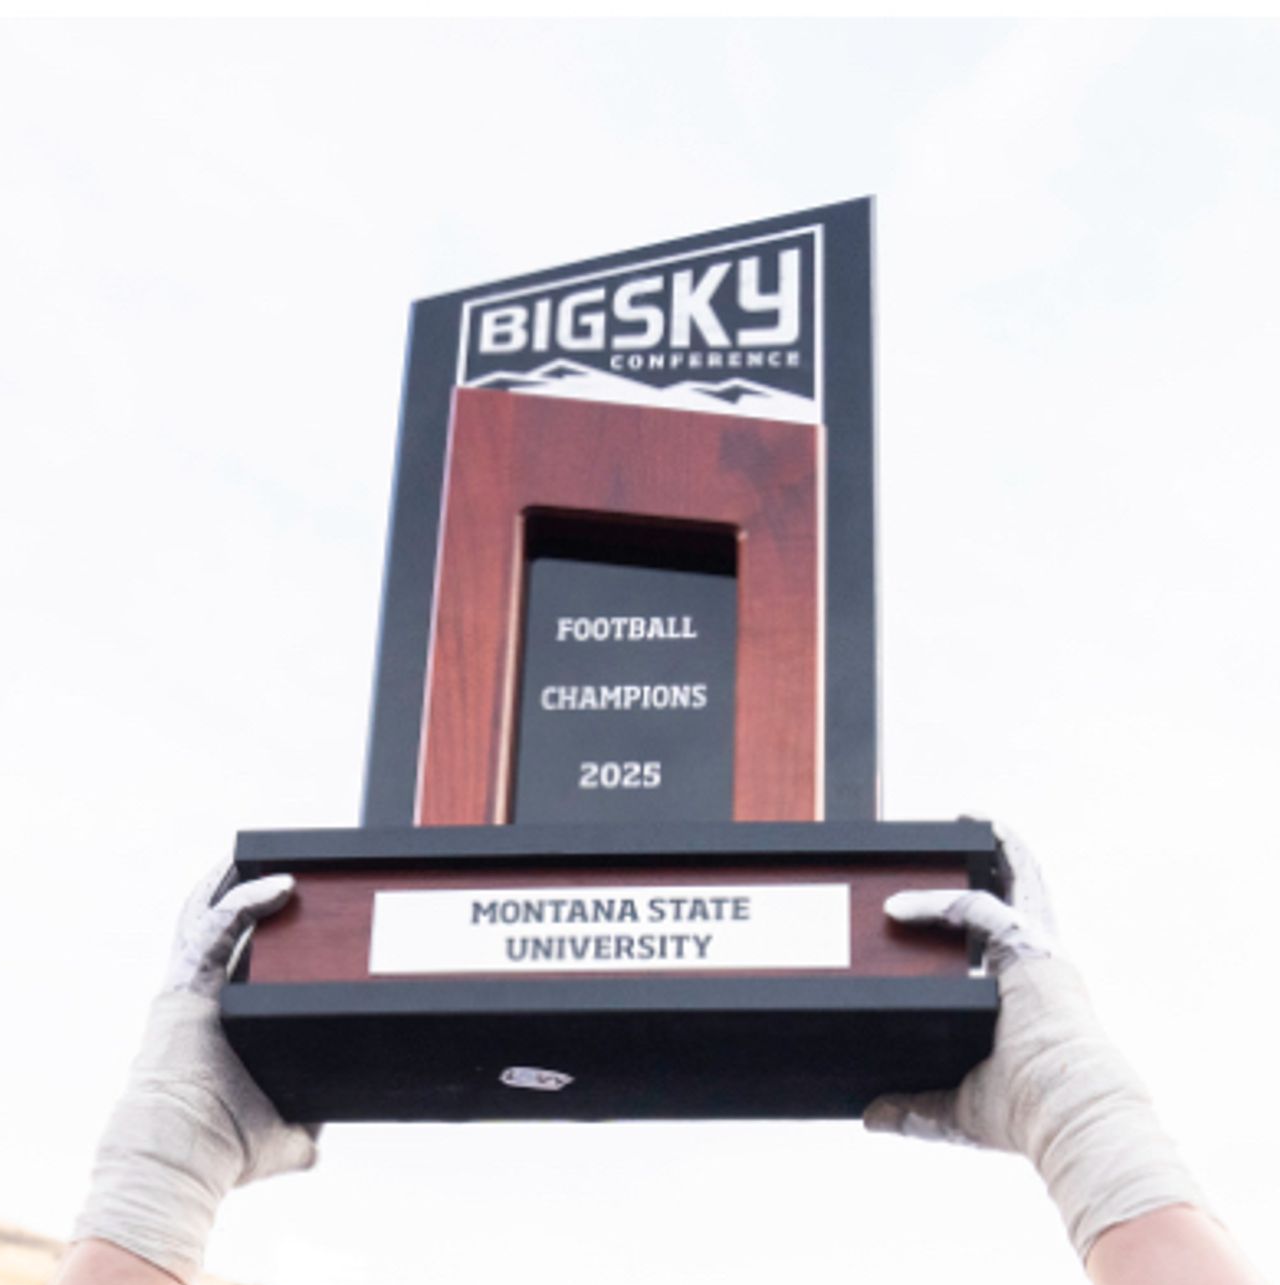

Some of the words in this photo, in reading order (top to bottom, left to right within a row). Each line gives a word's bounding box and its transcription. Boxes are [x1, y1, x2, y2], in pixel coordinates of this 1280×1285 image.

[609, 350, 802, 370] CONFERENCE
[556, 616, 698, 642] FOOTBALL
[540, 683, 708, 711] CHAMPIONS
[578, 761, 662, 789] 2025
[471, 899, 639, 925] MONTANA
[647, 896, 751, 922] STATE
[505, 933, 713, 962] UNIVERSITY
